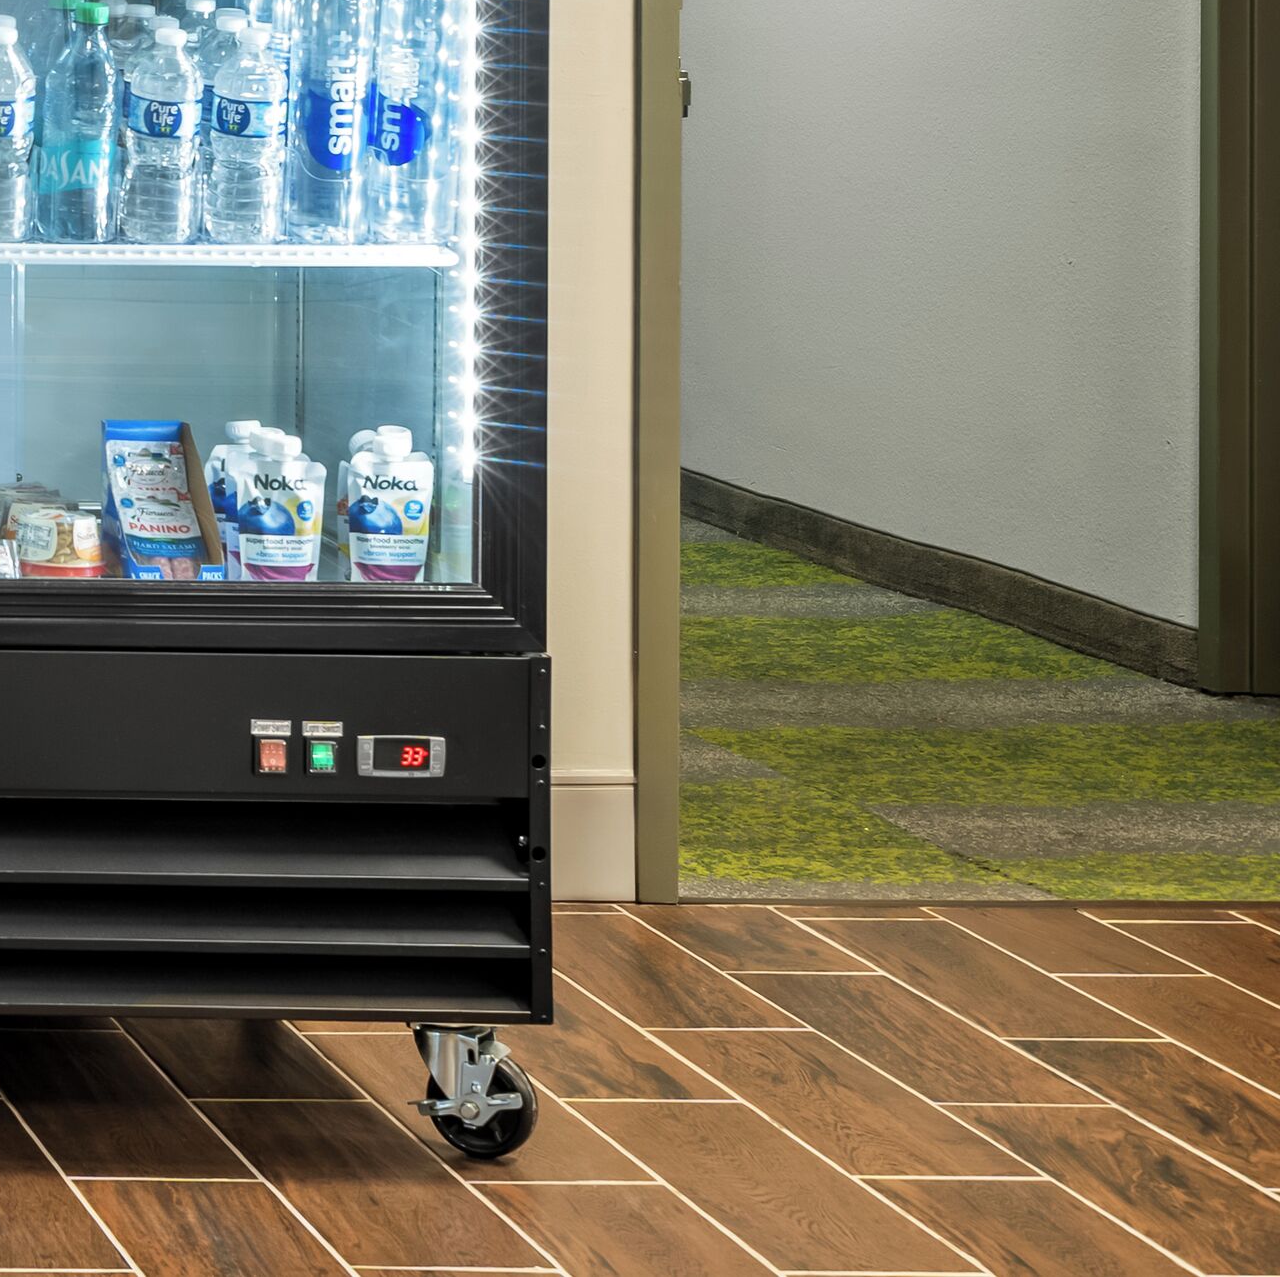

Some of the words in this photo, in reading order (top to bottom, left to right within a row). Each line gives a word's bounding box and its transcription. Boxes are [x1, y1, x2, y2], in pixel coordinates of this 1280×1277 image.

[150, 101, 178, 115] Pure
[220, 98, 245, 112] Pure
[152, 111, 175, 125] Life
[222, 110, 243, 124] Life
[254, 473, 306, 491] Noka
[362, 475, 419, 491] Noka
[129, 522, 190, 534] PANINO
[157, 542, 197, 552] SALAMI
[356, 536, 391, 546] superfood
[401, 747, 424, 766] 33
